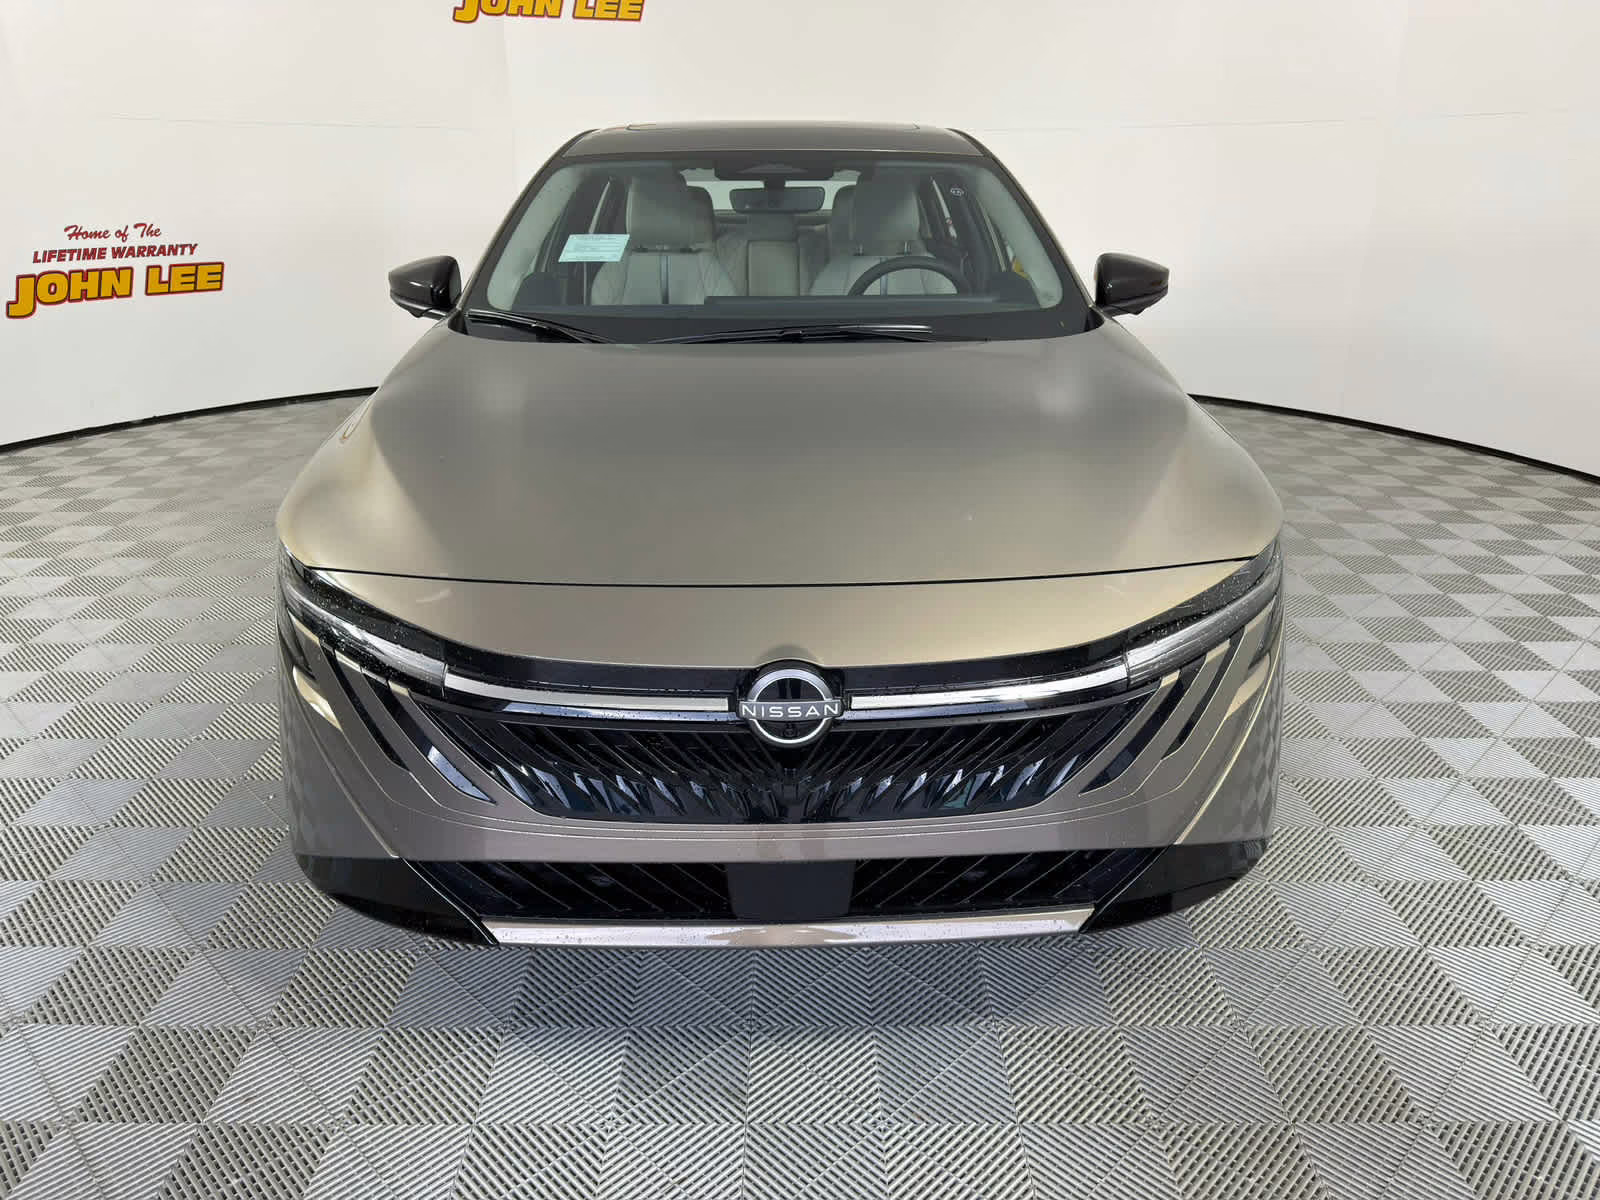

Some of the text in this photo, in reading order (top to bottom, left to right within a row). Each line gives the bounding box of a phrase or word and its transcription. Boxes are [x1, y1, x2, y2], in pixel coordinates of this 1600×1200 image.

[572, 0, 644, 21] LEE
[64, 222, 161, 242] Home of The
[32, 243, 198, 264] LIFETIME WARRANTY
[6, 262, 224, 319] JOHN LEE
[742, 703, 838, 718] NISSAN
